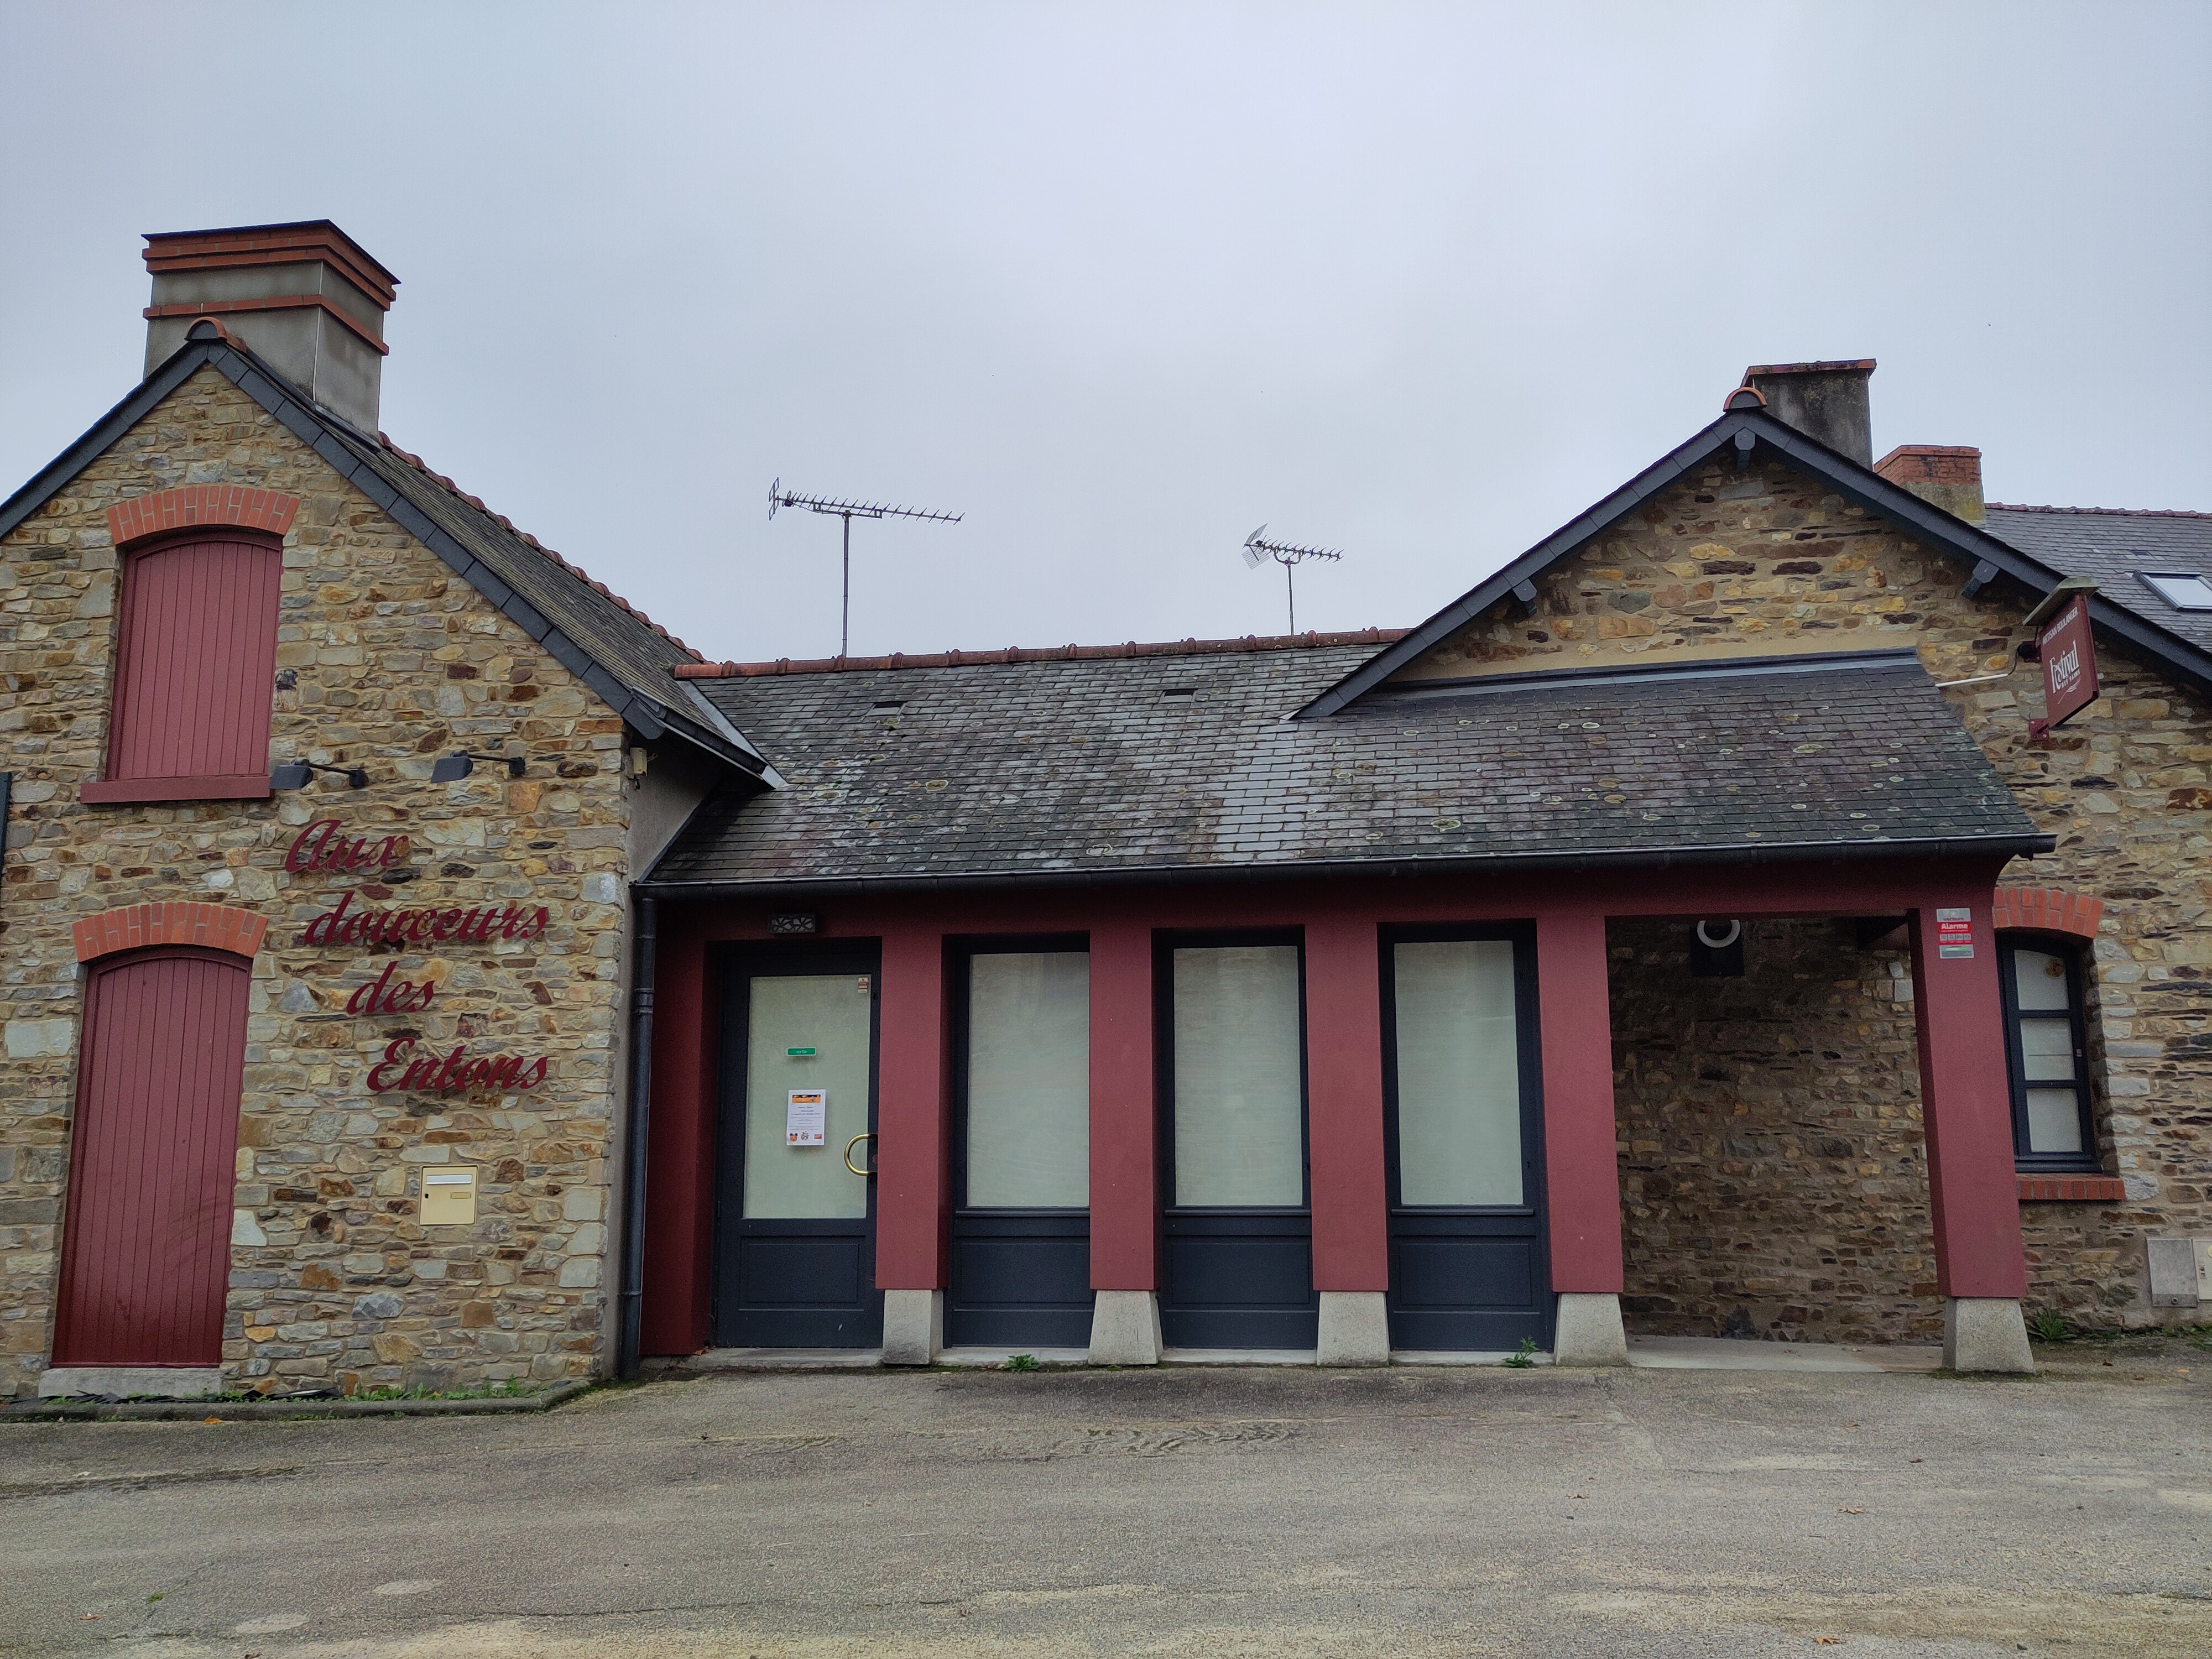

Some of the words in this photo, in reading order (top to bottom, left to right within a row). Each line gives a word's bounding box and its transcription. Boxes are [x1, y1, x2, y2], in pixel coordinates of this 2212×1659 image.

[2042, 626, 2057, 646] ARTISAN
[2057, 607, 2078, 633] BOULANGER
[2049, 639, 2080, 694] Festival
[285, 819, 408, 873] Aux
[304, 890, 549, 945] douceurs
[346, 961, 435, 1015] des
[367, 1036, 548, 1091] Entons
